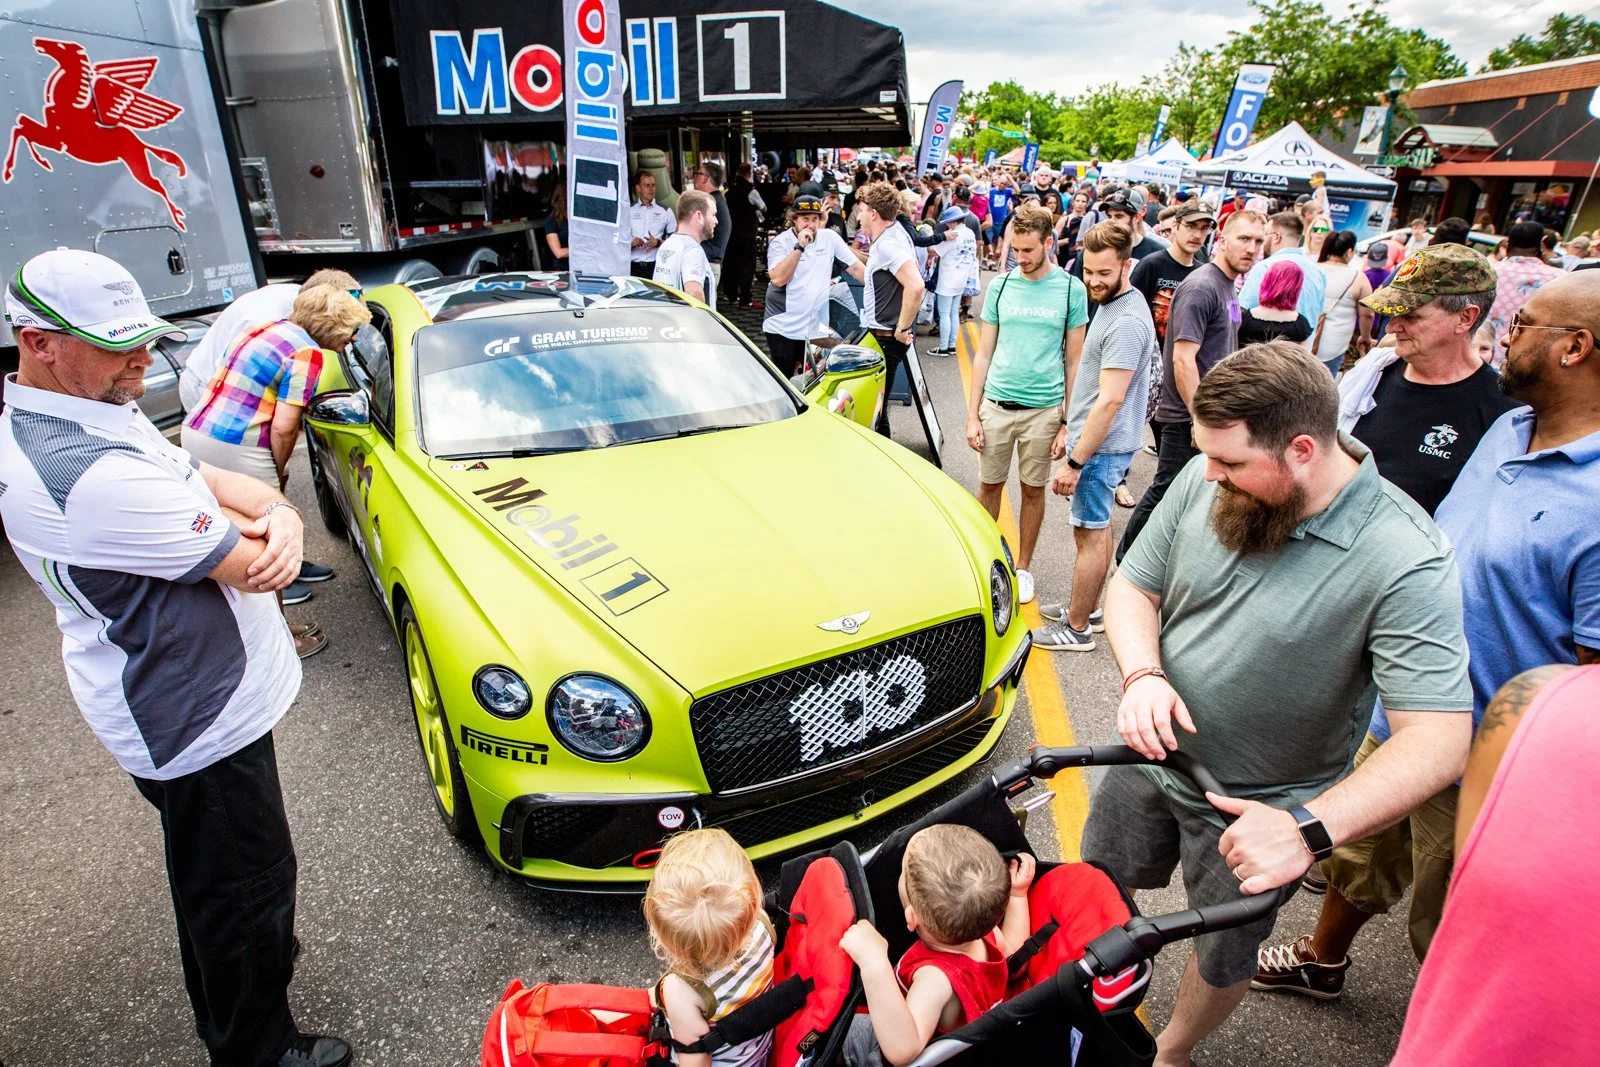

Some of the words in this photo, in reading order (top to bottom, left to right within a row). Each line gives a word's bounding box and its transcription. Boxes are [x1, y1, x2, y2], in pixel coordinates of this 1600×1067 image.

[429, 17, 680, 115] Moil
[723, 22, 751, 91] 1
[927, 104, 953, 159] Mobil
[1226, 94, 1257, 151] FO
[1265, 158, 1346, 170] ACURA
[1241, 172, 1289, 185] ACURA
[576, 180, 617, 201] 1
[108, 324, 138, 338] Mobil
[531, 330, 577, 345] GRAN
[580, 326, 648, 339] TURISMO
[1418, 444, 1451, 460] USMC
[472, 477, 619, 570] Mobil
[600, 571, 651, 602] 1
[788, 654, 926, 761] 100
[460, 724, 549, 766] PIRELLI
[660, 813, 682, 822] TOW
